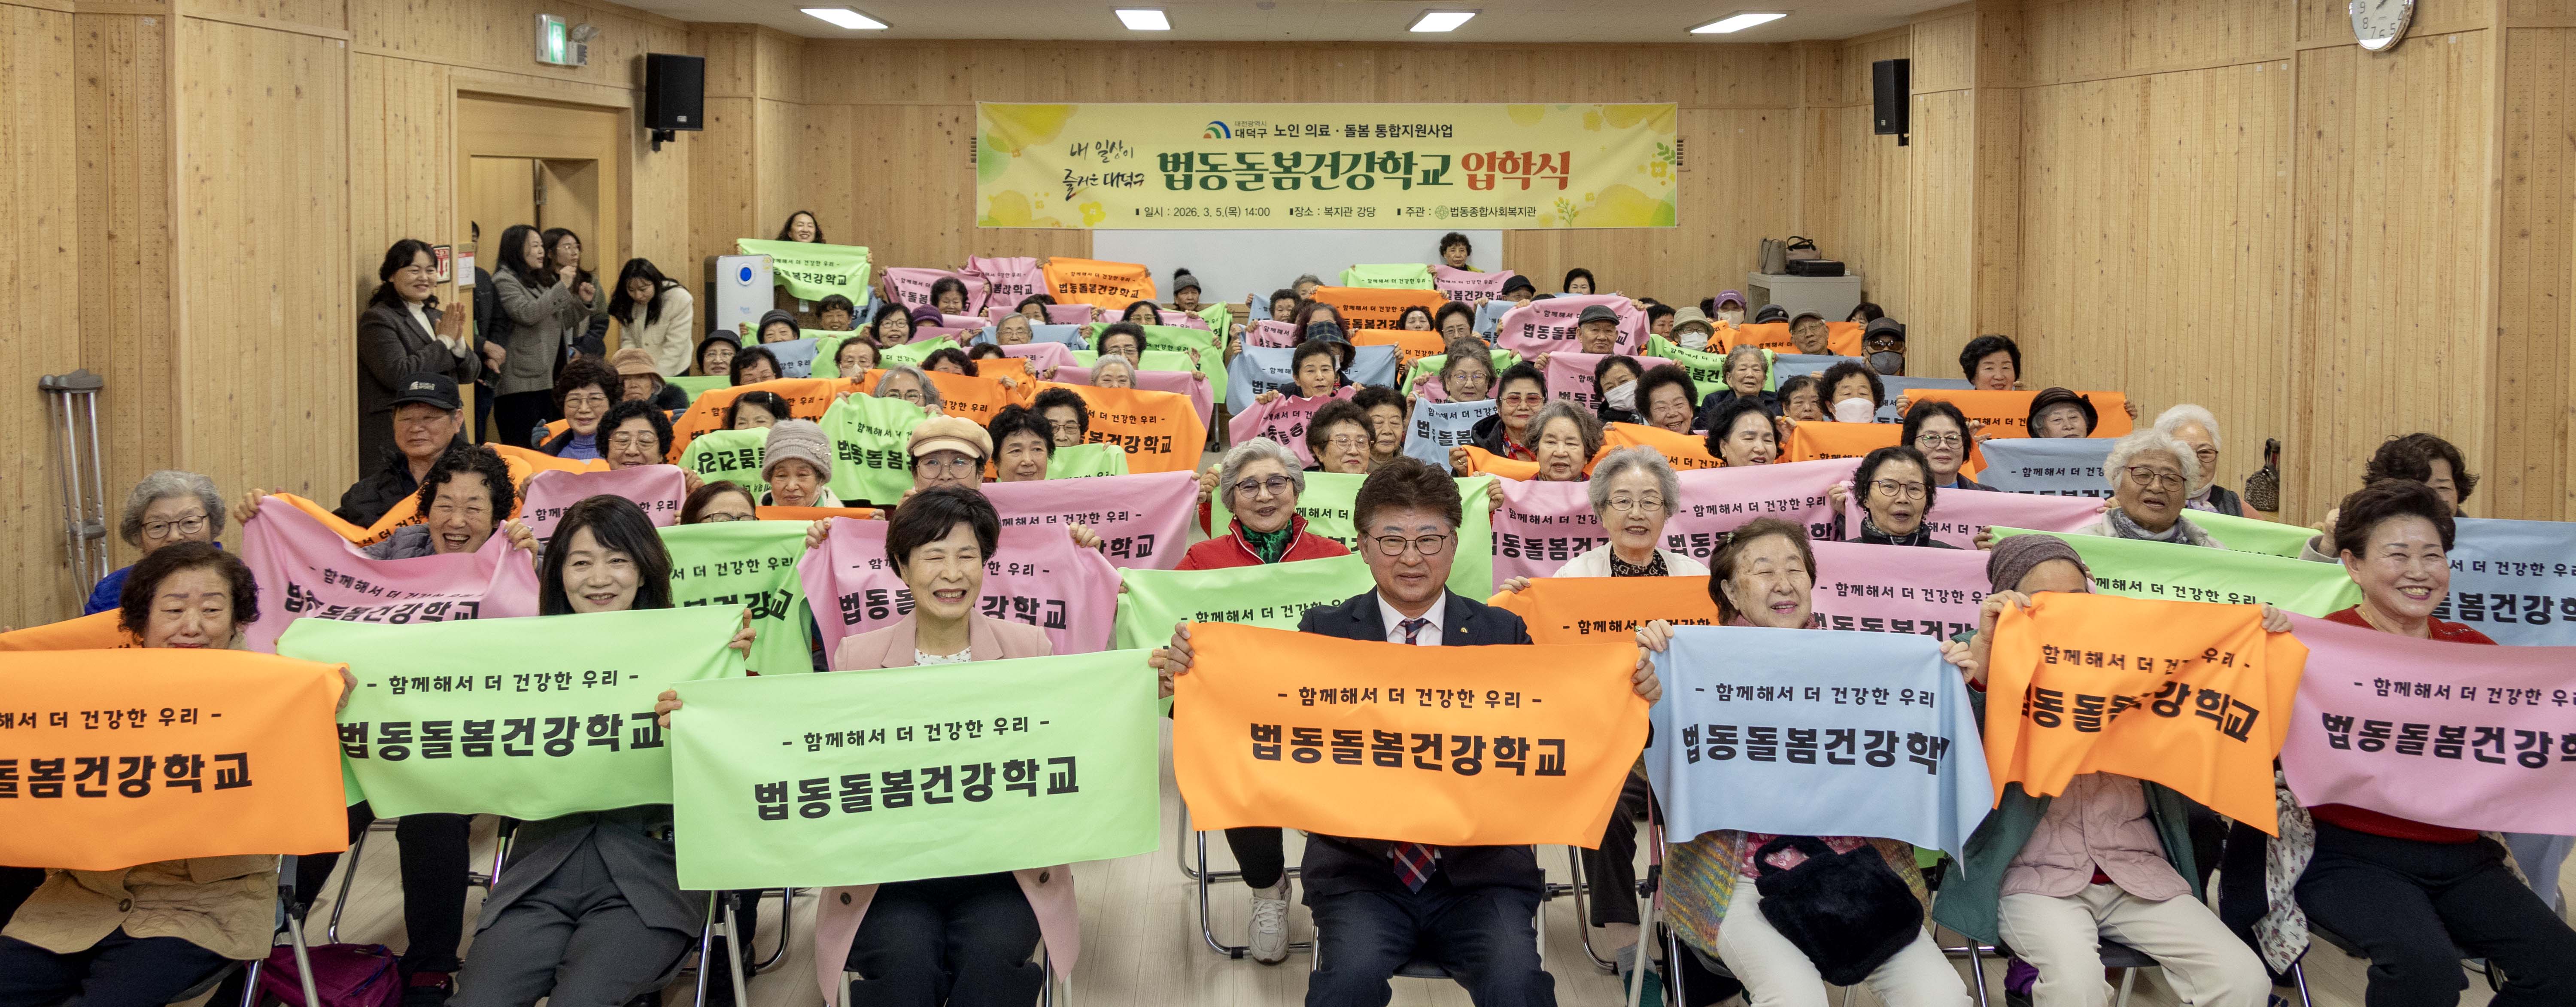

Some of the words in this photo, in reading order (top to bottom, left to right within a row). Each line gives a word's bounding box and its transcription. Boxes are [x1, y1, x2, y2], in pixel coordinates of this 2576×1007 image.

[2363, 17, 2369, 29] 8
[1235, 128, 1267, 138] 대덕구
[1274, 124, 1300, 138] 노인
[1305, 124, 1331, 138] 의료
[1344, 124, 1370, 138] 돌봄
[1376, 124, 1453, 138] 통합지원사업
[1069, 142, 1089, 160] 내
[1095, 140, 1134, 163] 일상이
[1157, 151, 1454, 191] 법동돌봄건강학교
[1461, 150, 1571, 191] 입학식
[1063, 168, 1099, 201] 즐거운
[1103, 170, 1145, 189] 대덕구
[1144, 207, 1163, 217] 일시
[1173, 207, 1200, 217] 2026.
[1203, 208, 1212, 217] 3.
[1244, 207, 1270, 217] 14:00
[1294, 206, 1314, 217] 장소
[1324, 206, 1353, 218] 복지관
[1356, 206, 1376, 218] 강당
[1405, 206, 1425, 218] 주관
[1450, 206, 1536, 218] 법동종합사회복지관
[1543, 310, 1573, 319] 함께해서
[1264, 325, 1290, 336] 함께해서
[800, 397, 814, 406] 우리
[971, 403, 988, 412] 우리
[1100, 412, 1107, 420] 더
[1111, 414, 1137, 425] 건강한
[1140, 415, 1157, 424] 우리
[1462, 410, 1470, 418] 더
[857, 422, 892, 438] 함께해서
[837, 440, 911, 470] 법동돌봄
[1684, 457, 1693, 466] 더
[2022, 467, 2065, 477] 함께해서
[2071, 467, 2080, 476] 더
[656, 500, 677, 512] 우리
[1693, 502, 1742, 518] 함께해서
[1748, 500, 1759, 513] 더
[1767, 497, 1801, 512] 건강한
[1805, 495, 1826, 508] 우리
[1063, 511, 1100, 525] 건강한
[1106, 511, 1128, 523] 우리
[1509, 507, 1552, 525] 함께해서
[1559, 516, 1569, 524] 더
[1957, 524, 1968, 535] 더
[693, 565, 706, 577] 더
[714, 559, 760, 577] 건강한
[767, 557, 793, 570] 우리
[1007, 561, 1034, 576] 우리
[2473, 560, 2486, 573] 더
[2494, 560, 2545, 577] 건강한
[324, 568, 384, 597] 함께해서
[1835, 582, 1894, 599] 함께해서
[1902, 587, 1914, 599] 더
[1925, 588, 1965, 604] 건강한
[2151, 583, 2164, 596] 더
[2172, 585, 2219, 601] 건강한
[2228, 591, 2257, 605] 우리
[1195, 608, 1254, 623] 함께해서
[1261, 605, 1275, 619] 더
[1577, 620, 1637, 635] 함께해서
[2042, 644, 2126, 671] 함께해서
[2137, 657, 2154, 673] 더
[2201, 647, 2235, 668] 우리
[389, 674, 474, 695] 함께해서
[485, 675, 502, 691] 더
[513, 670, 573, 693] 건강한
[582, 669, 619, 687] 우리
[1298, 687, 1378, 706] 함께해서
[1388, 688, 1404, 704] 더
[1419, 687, 1475, 709] 건강한
[1484, 691, 1521, 709] 우리
[1716, 683, 1793, 703] 함께해서
[1804, 688, 1820, 702] 더
[1831, 687, 1889, 706] 건강한
[1899, 688, 1935, 708] 우리
[2373, 677, 2450, 700] 함께해서
[2460, 687, 2476, 701] 더
[2487, 687, 2542, 706] 건강한
[49, 711, 68, 728] 더
[80, 708, 148, 730] 건강한
[159, 707, 198, 726] 우리
[336, 711, 665, 762] 법동돌봄건강학교
[803, 728, 886, 752] 함께해서
[896, 726, 913, 743] 더
[923, 719, 984, 742] 건강한
[993, 715, 1030, 736] 우리
[1250, 723, 1567, 776] 법동돌봄건강학교
[1682, 723, 1950, 776] 법동돌봄건강학
[754, 755, 1079, 821] 법동돌봄건강학교
